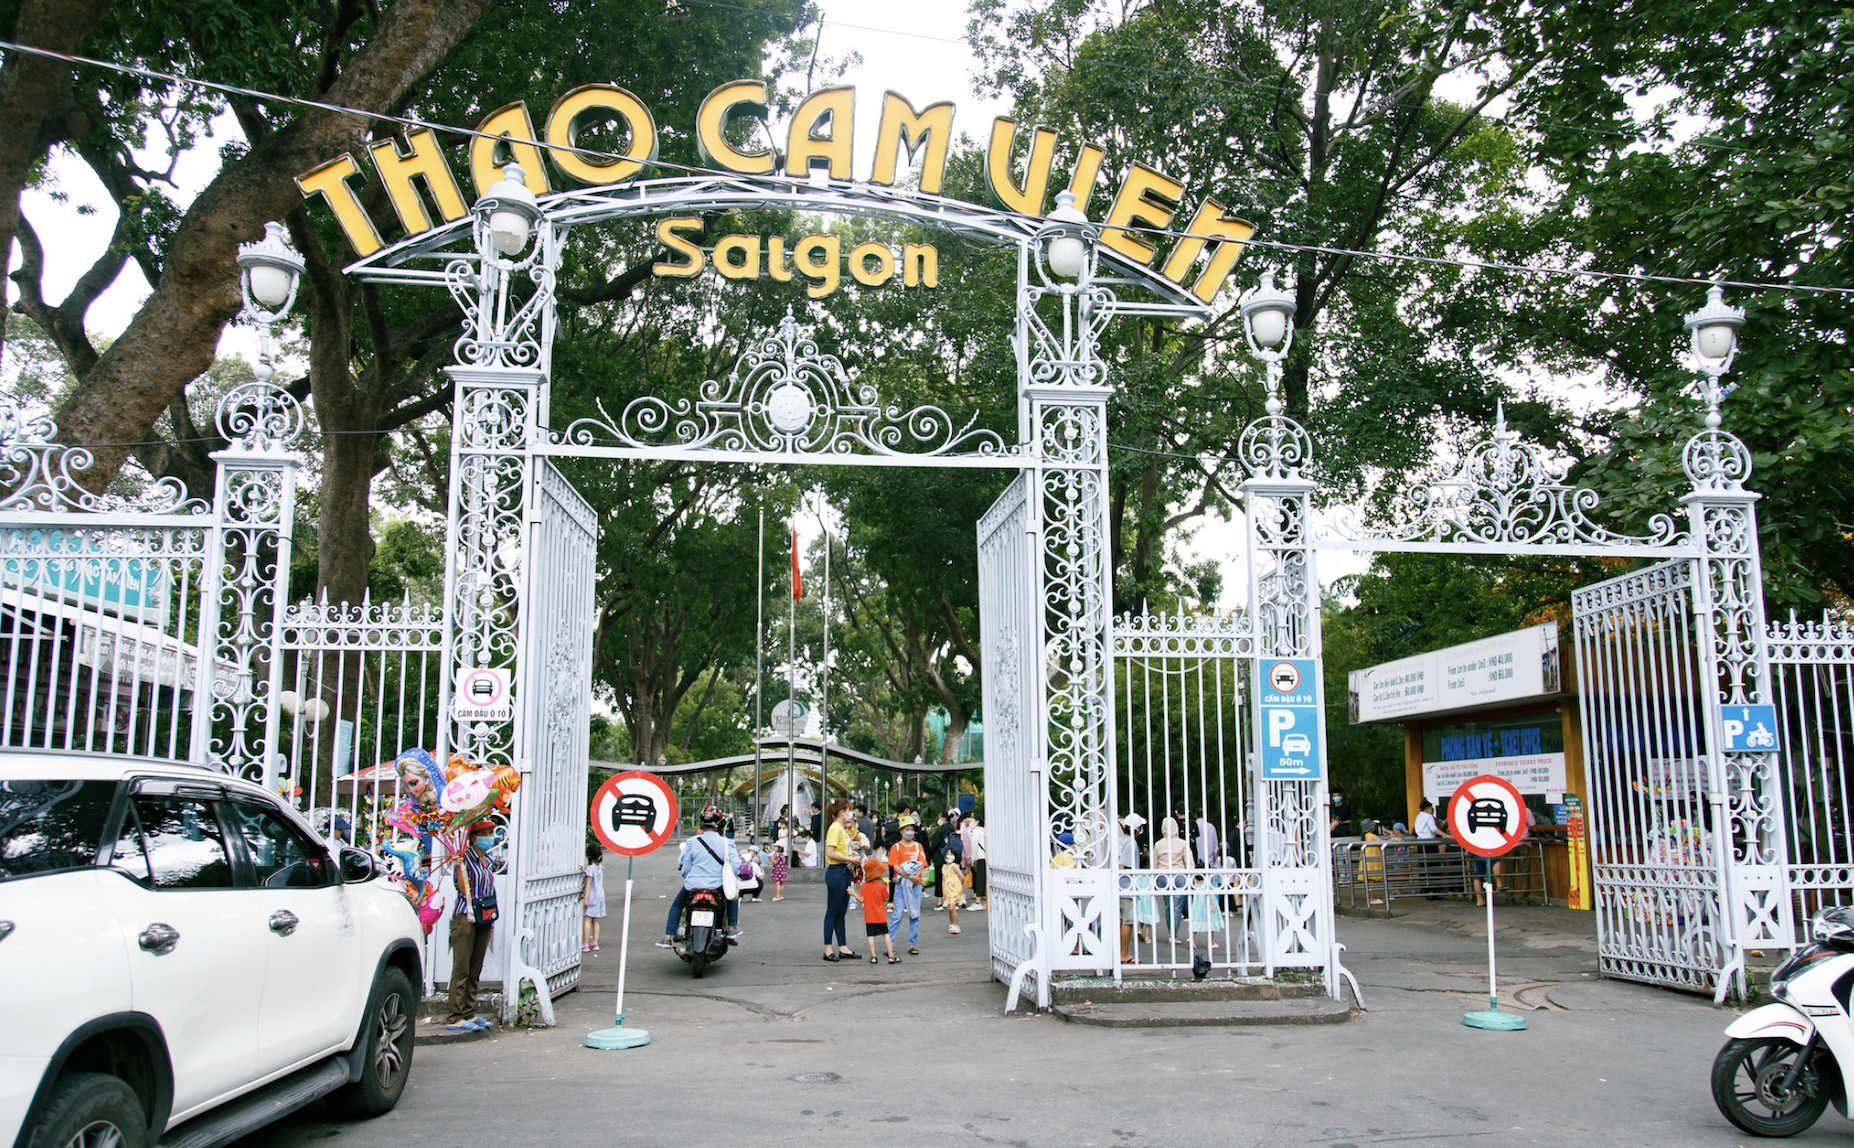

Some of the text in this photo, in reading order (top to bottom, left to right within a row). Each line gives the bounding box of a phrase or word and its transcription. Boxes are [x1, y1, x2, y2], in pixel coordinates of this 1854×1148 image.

[294, 83, 659, 257] THAO
[696, 79, 956, 196] CAM
[653, 216, 938, 298] Saigon
[1448, 666, 1457, 675] From
[1467, 661, 1477, 671] under
[1448, 680, 1457, 690] From
[1478, 687, 1496, 696] refund
[1265, 694, 1312, 703] CẤM ĐẬU Ô TÔ
[458, 707, 473, 717] CẤM
[1269, 709, 1296, 748] P
[1723, 720, 1744, 749] P
[1279, 757, 1304, 767] 50m
